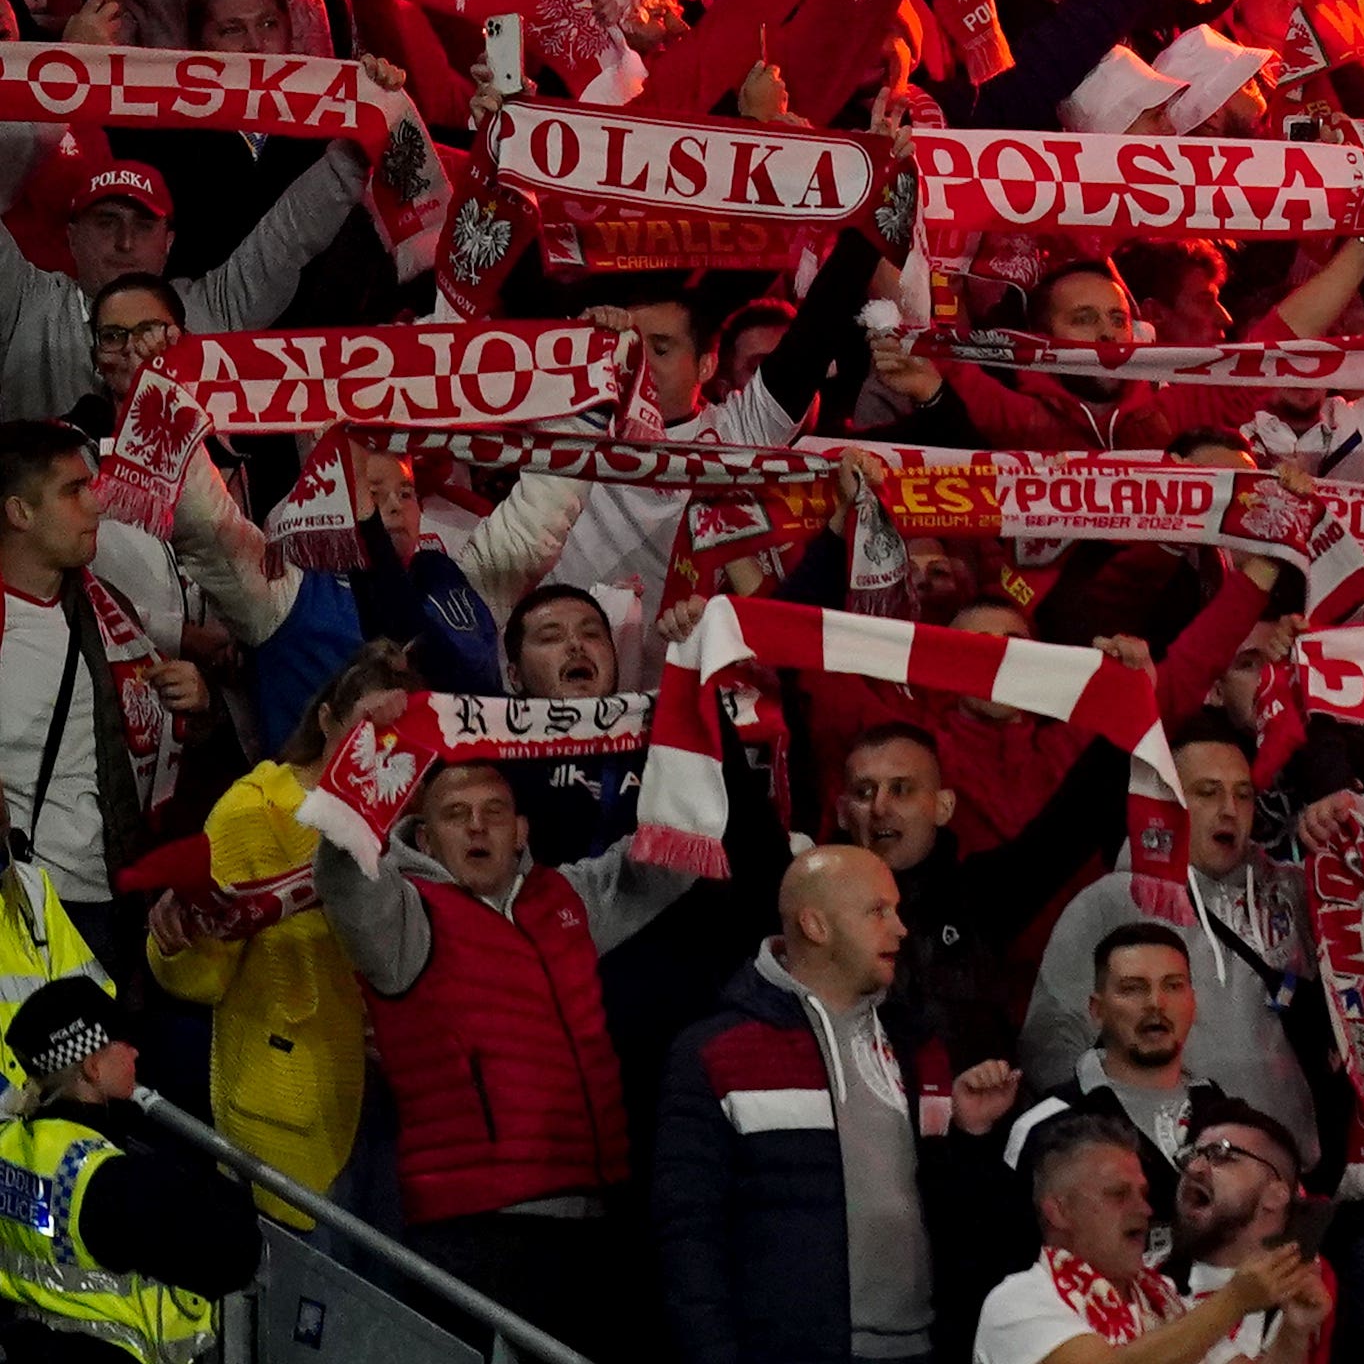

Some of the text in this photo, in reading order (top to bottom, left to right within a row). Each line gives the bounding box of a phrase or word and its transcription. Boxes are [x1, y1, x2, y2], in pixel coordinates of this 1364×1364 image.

[0, 49, 360, 129] OLSKA
[90, 170, 153, 194] POLSKA
[916, 138, 1336, 231] POLSKA
[1016, 478, 1213, 516] POLAND
[1136, 516, 1183, 531] 2022
